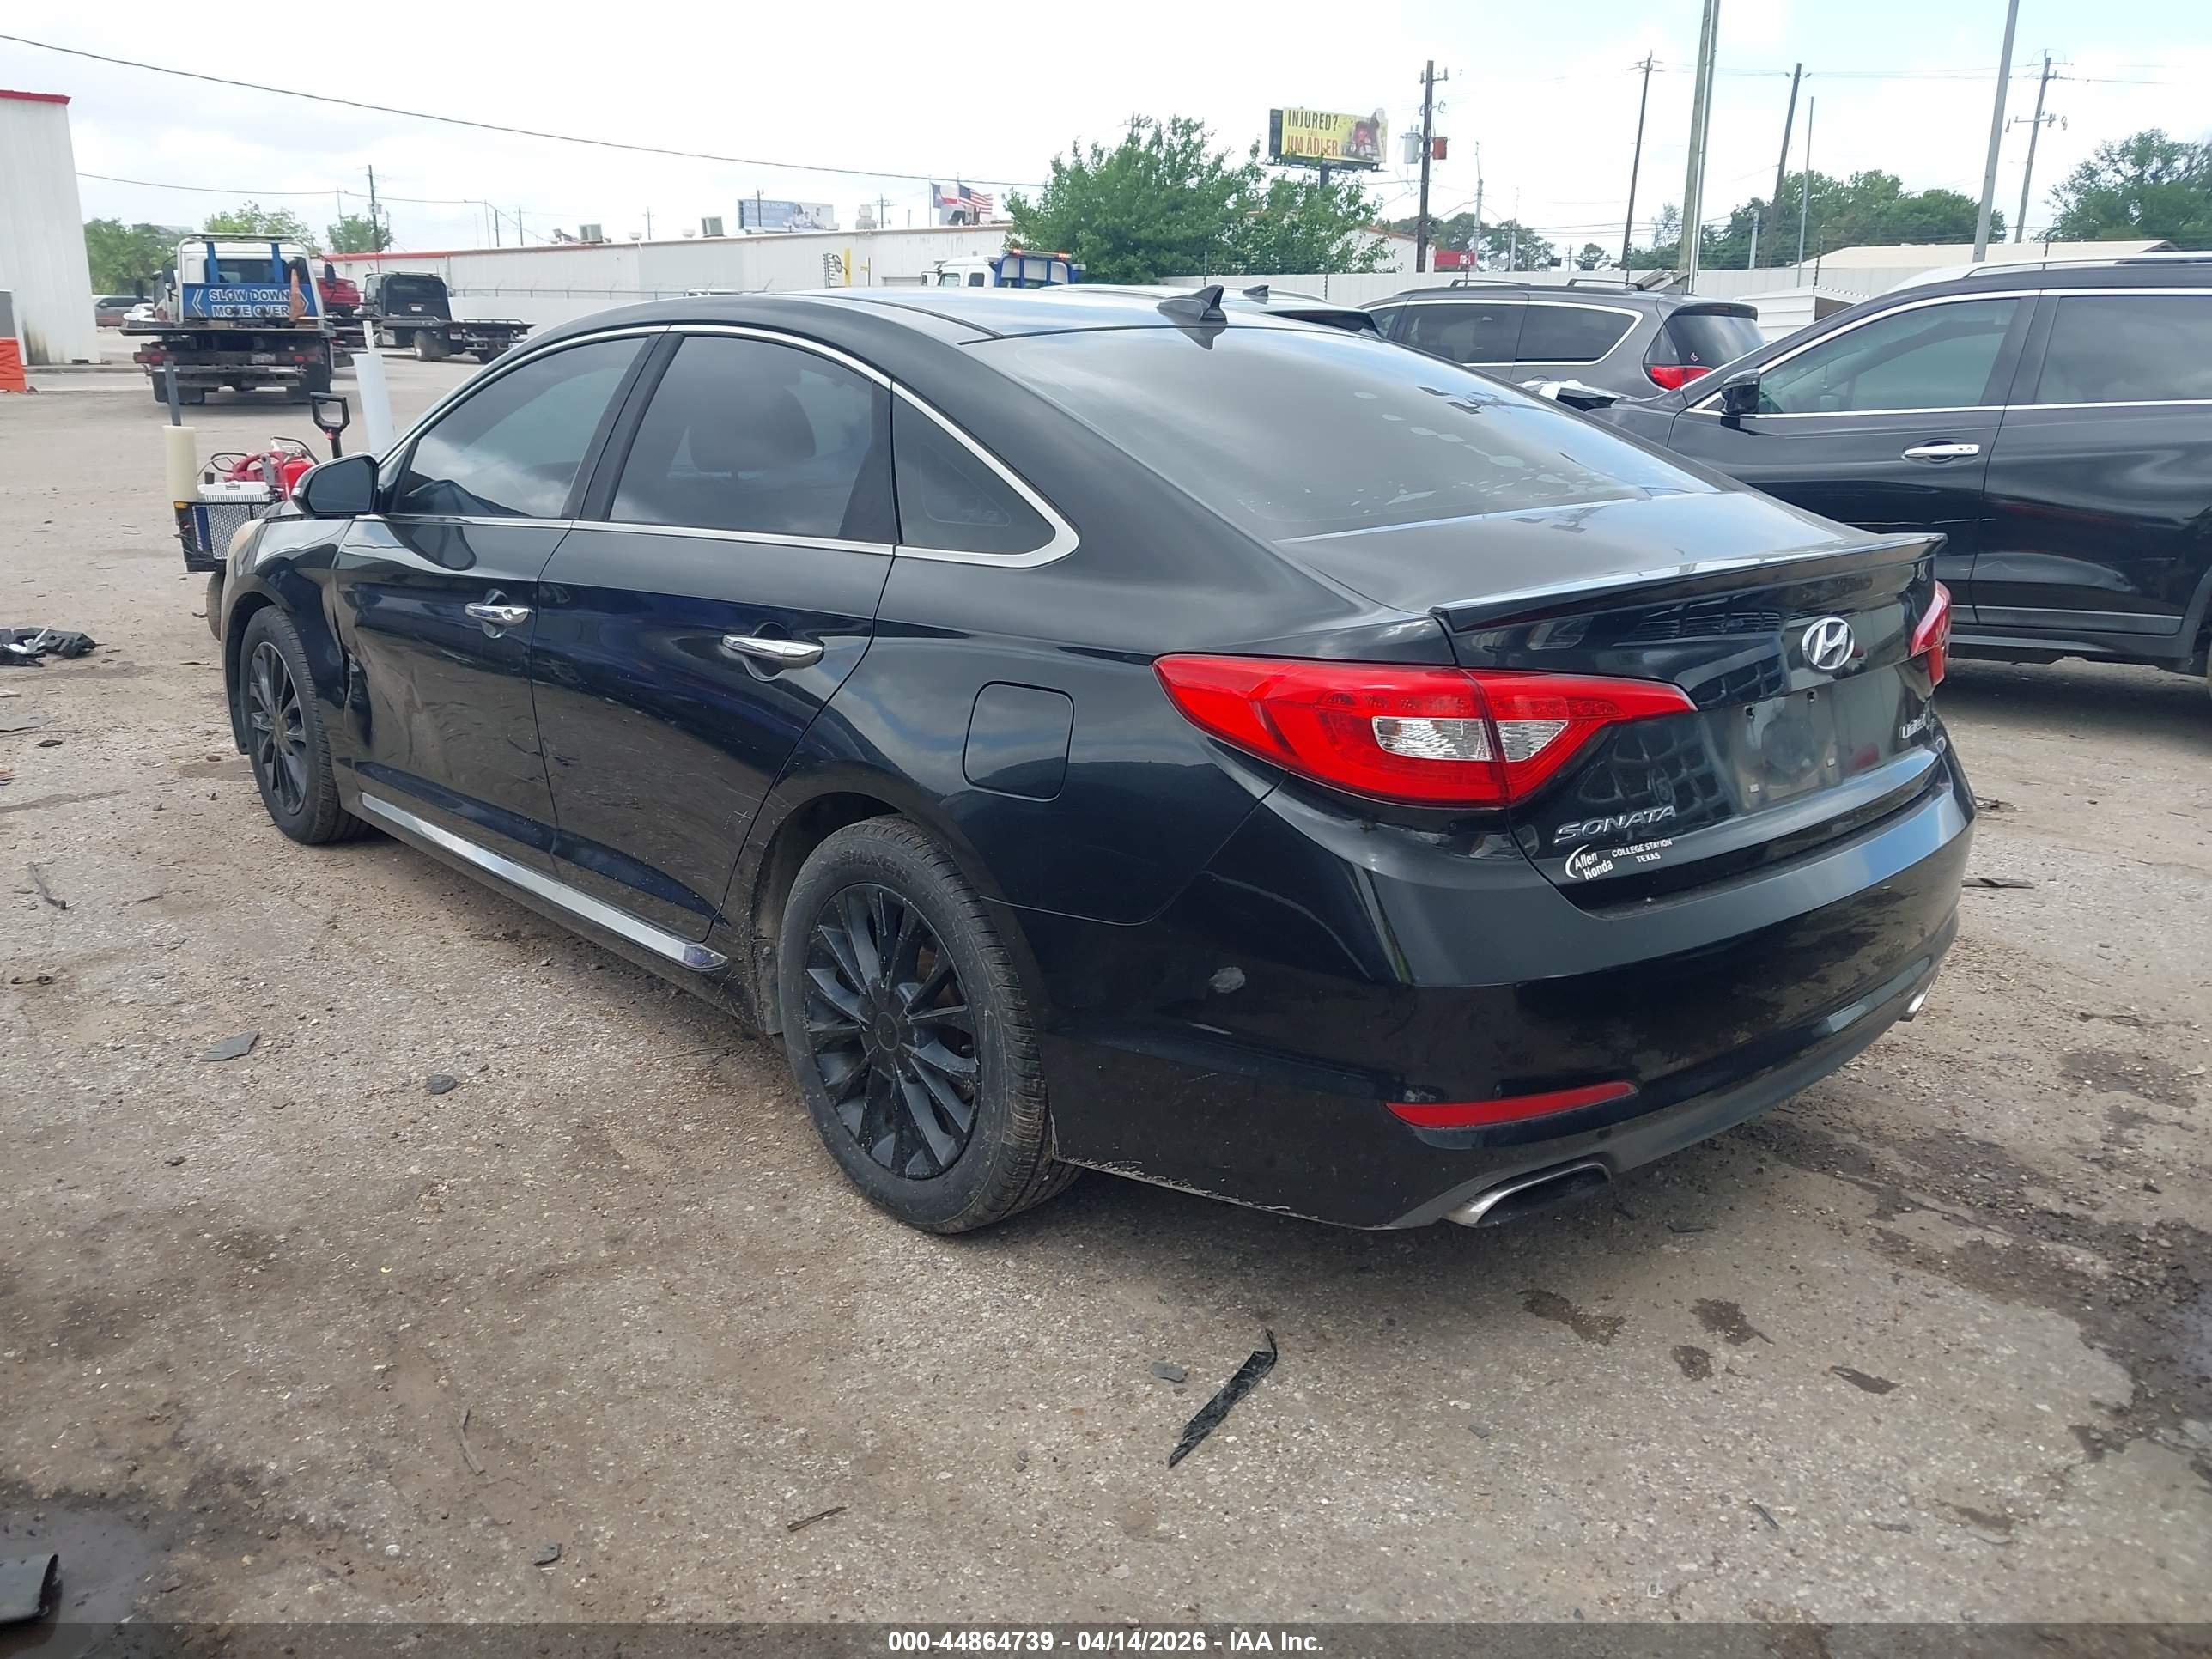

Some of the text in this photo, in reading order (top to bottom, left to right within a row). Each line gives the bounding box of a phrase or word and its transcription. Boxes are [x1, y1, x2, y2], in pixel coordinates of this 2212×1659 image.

[1288, 110, 1338, 131] INJURED?
[1306, 137, 1338, 156] ADLER
[209, 289, 290, 301] SLOW DOWN
[211, 304, 290, 317] MOVE OVER
[1553, 805, 1676, 843] SONATA
[1612, 838, 1673, 858] COLLEGE STATION
[1575, 852, 1598, 871] Allen
[1636, 852, 1662, 864] TEXAS
[1583, 860, 1613, 880] Honda
